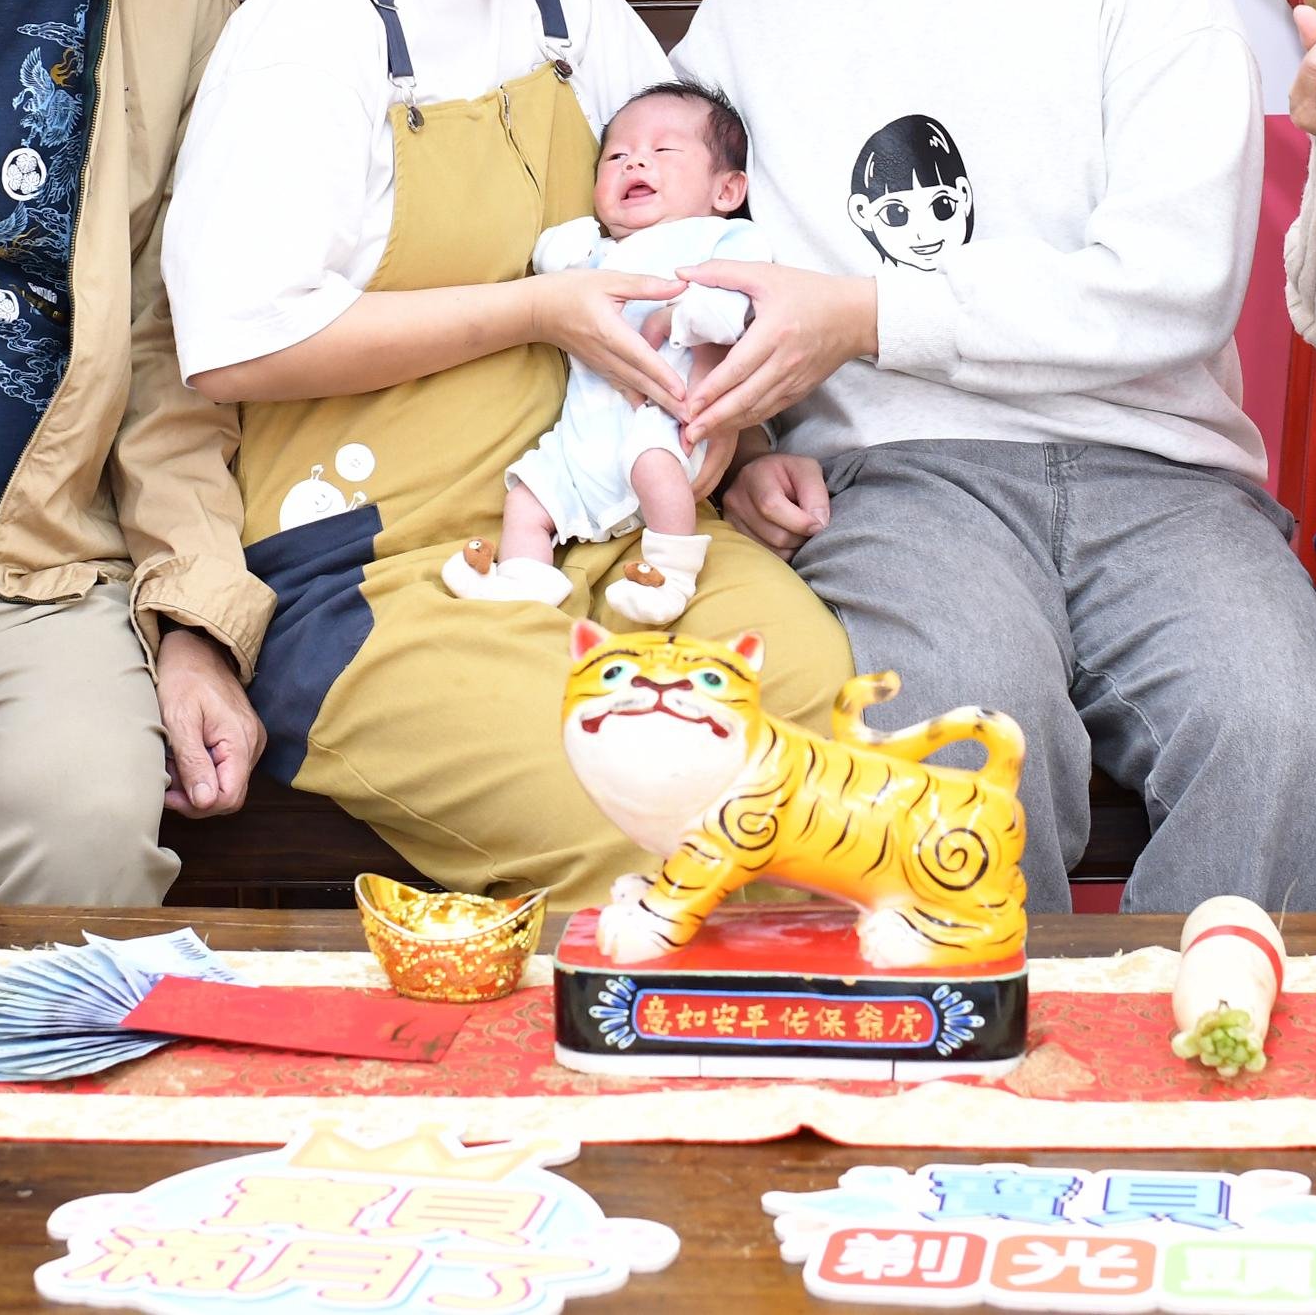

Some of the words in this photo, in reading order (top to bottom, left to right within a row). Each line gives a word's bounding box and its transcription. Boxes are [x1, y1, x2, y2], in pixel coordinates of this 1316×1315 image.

[170, 937, 207, 960] 1000
[63, 1226, 594, 1308] 滿月了
